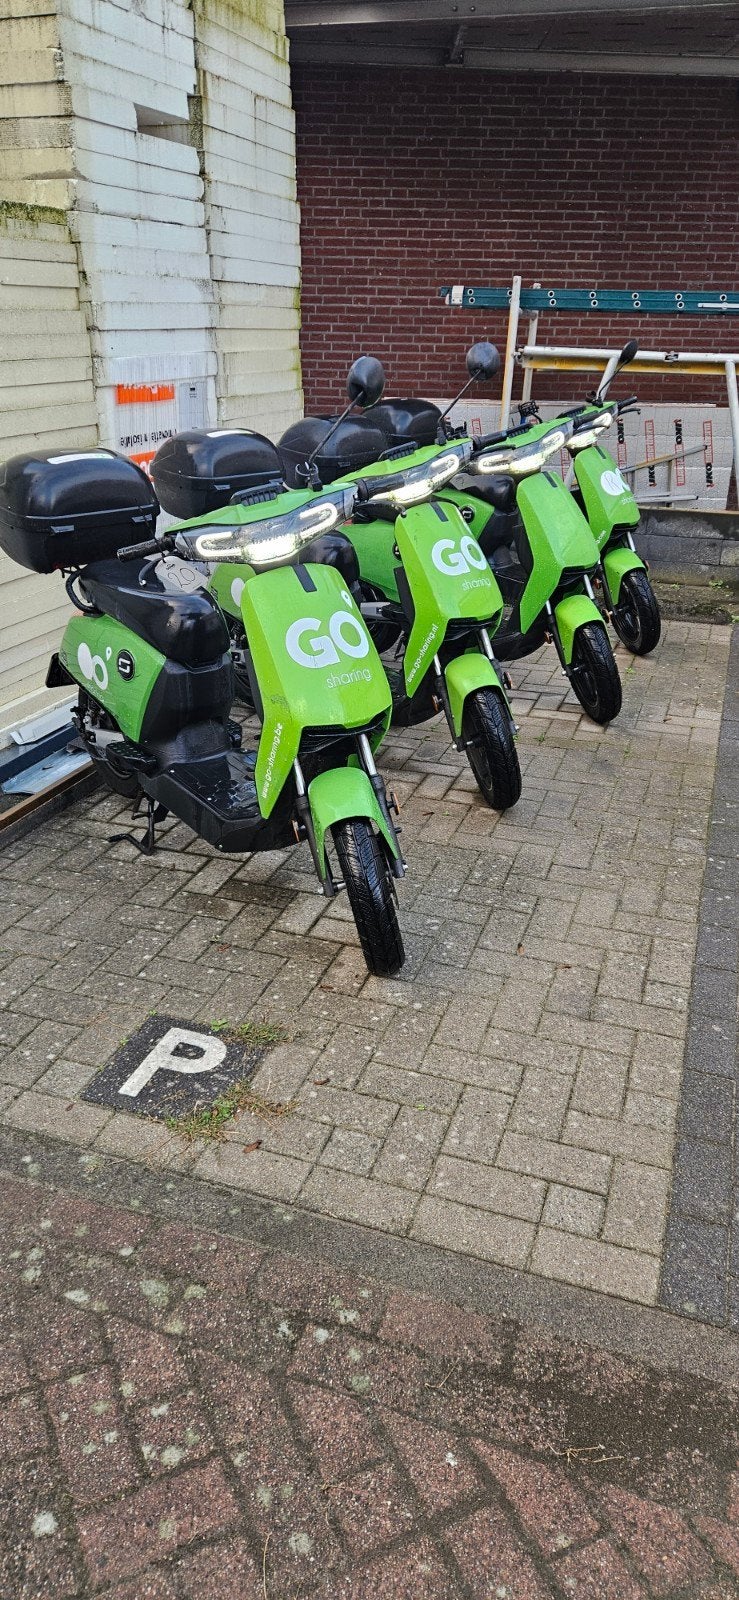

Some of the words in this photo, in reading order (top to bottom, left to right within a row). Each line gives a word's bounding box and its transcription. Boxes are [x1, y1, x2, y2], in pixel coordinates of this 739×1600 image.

[168, 567, 196, 588] 20
[432, 536, 487, 576] GO
[462, 577, 491, 591] sharing
[285, 610, 370, 669] GO
[407, 623, 439, 683] www.go-sharing.nl
[326, 667, 372, 689] sharing
[261, 722, 283, 799] www.go-sharing.be
[118, 1027, 227, 1098] P
